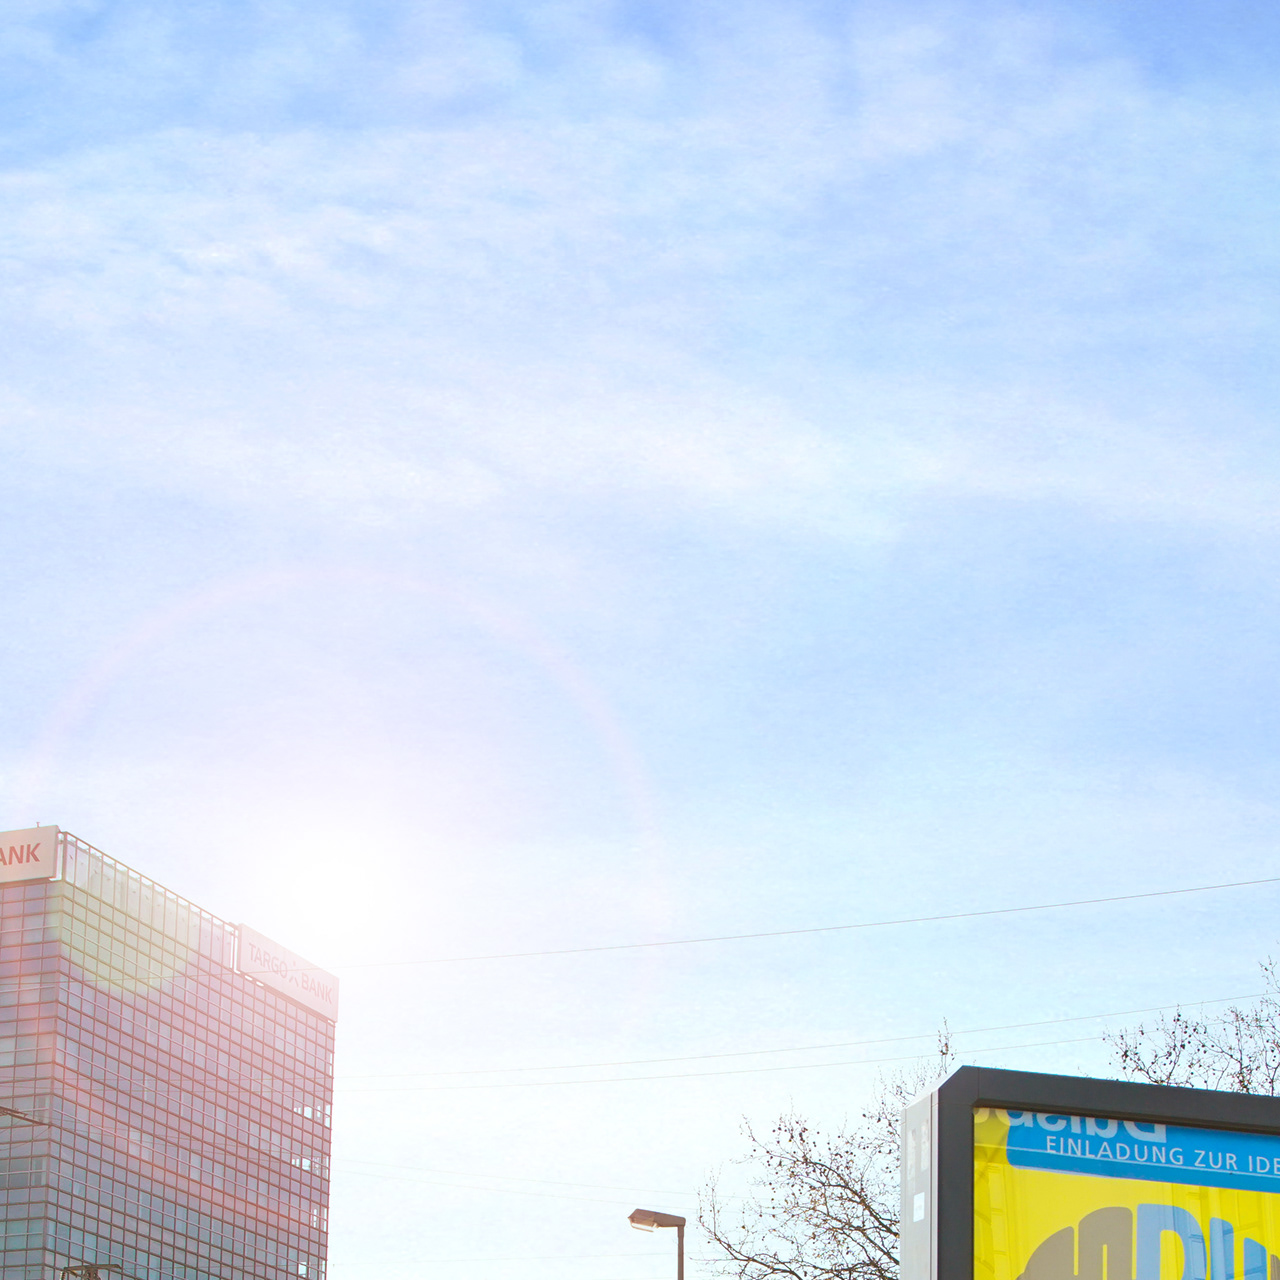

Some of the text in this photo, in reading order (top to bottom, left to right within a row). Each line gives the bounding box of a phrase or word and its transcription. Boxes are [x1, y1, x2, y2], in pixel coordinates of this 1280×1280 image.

[248, 942, 333, 1005] TARGO BANK
[1046, 1135, 1183, 1166] EINLADUNG
[1194, 1149, 1238, 1171] ZUR
